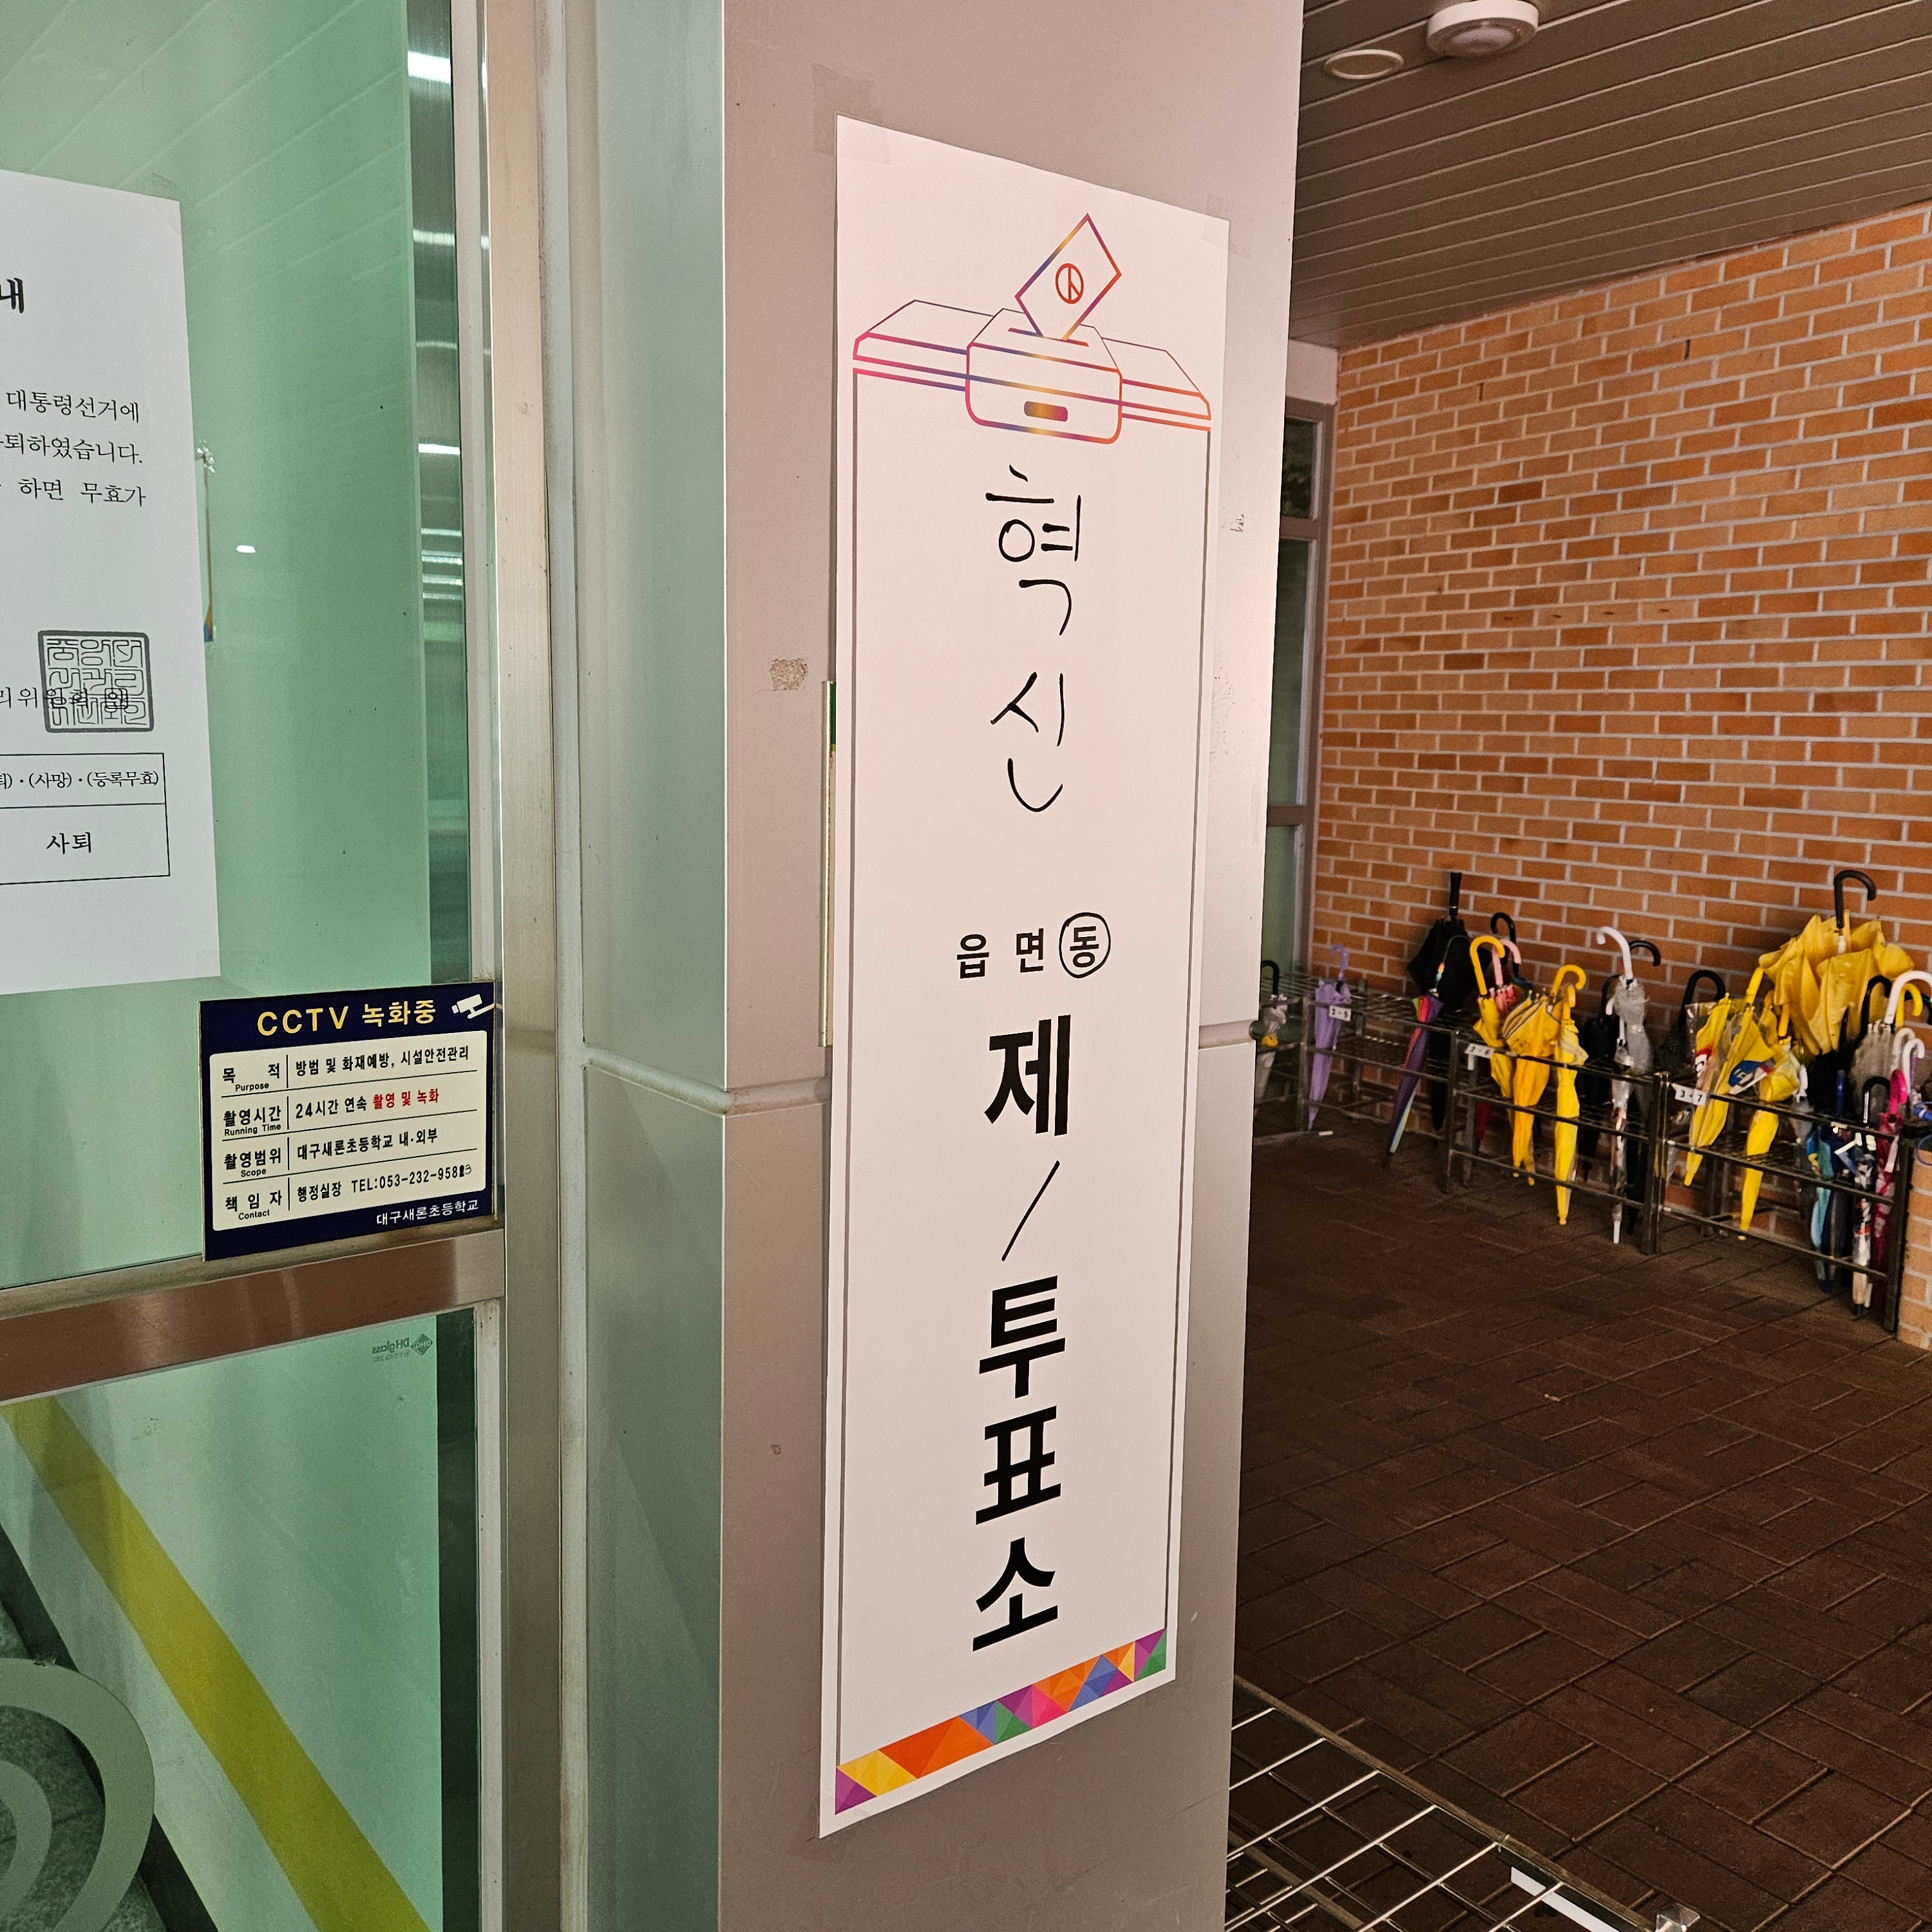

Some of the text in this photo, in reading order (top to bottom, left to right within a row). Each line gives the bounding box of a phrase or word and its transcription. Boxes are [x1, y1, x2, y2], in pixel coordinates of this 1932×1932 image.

[5, 388, 140, 424] 대통령선거에
[0, 432, 143, 465] 퇴하였습니다.
[18, 477, 147, 507] 하면 무효가
[46, 832, 92, 855] 사퇴
[956, 933, 990, 979] 읍
[1016, 927, 1045, 973] 면
[257, 999, 437, 1036] CCTV 녹화중
[295, 1045, 469, 1077] 방범 및 화재예방, 시설안전관리
[235, 1083, 270, 1092] Purpose
[223, 1105, 281, 1128] 촬영시간
[296, 1088, 440, 1119] 24시간 연속 촬영 및 녹화
[223, 1124, 281, 1137] Running Time
[297, 1128, 439, 1160] 대구새론초등학교 내·외부
[223, 1147, 281, 1171] 촬영범위
[240, 1168, 267, 1178] Scope
[297, 1181, 342, 1202] 행정실장
[238, 1209, 270, 1220] Contact
[376, 1198, 479, 1226] 대구새론초등학교
